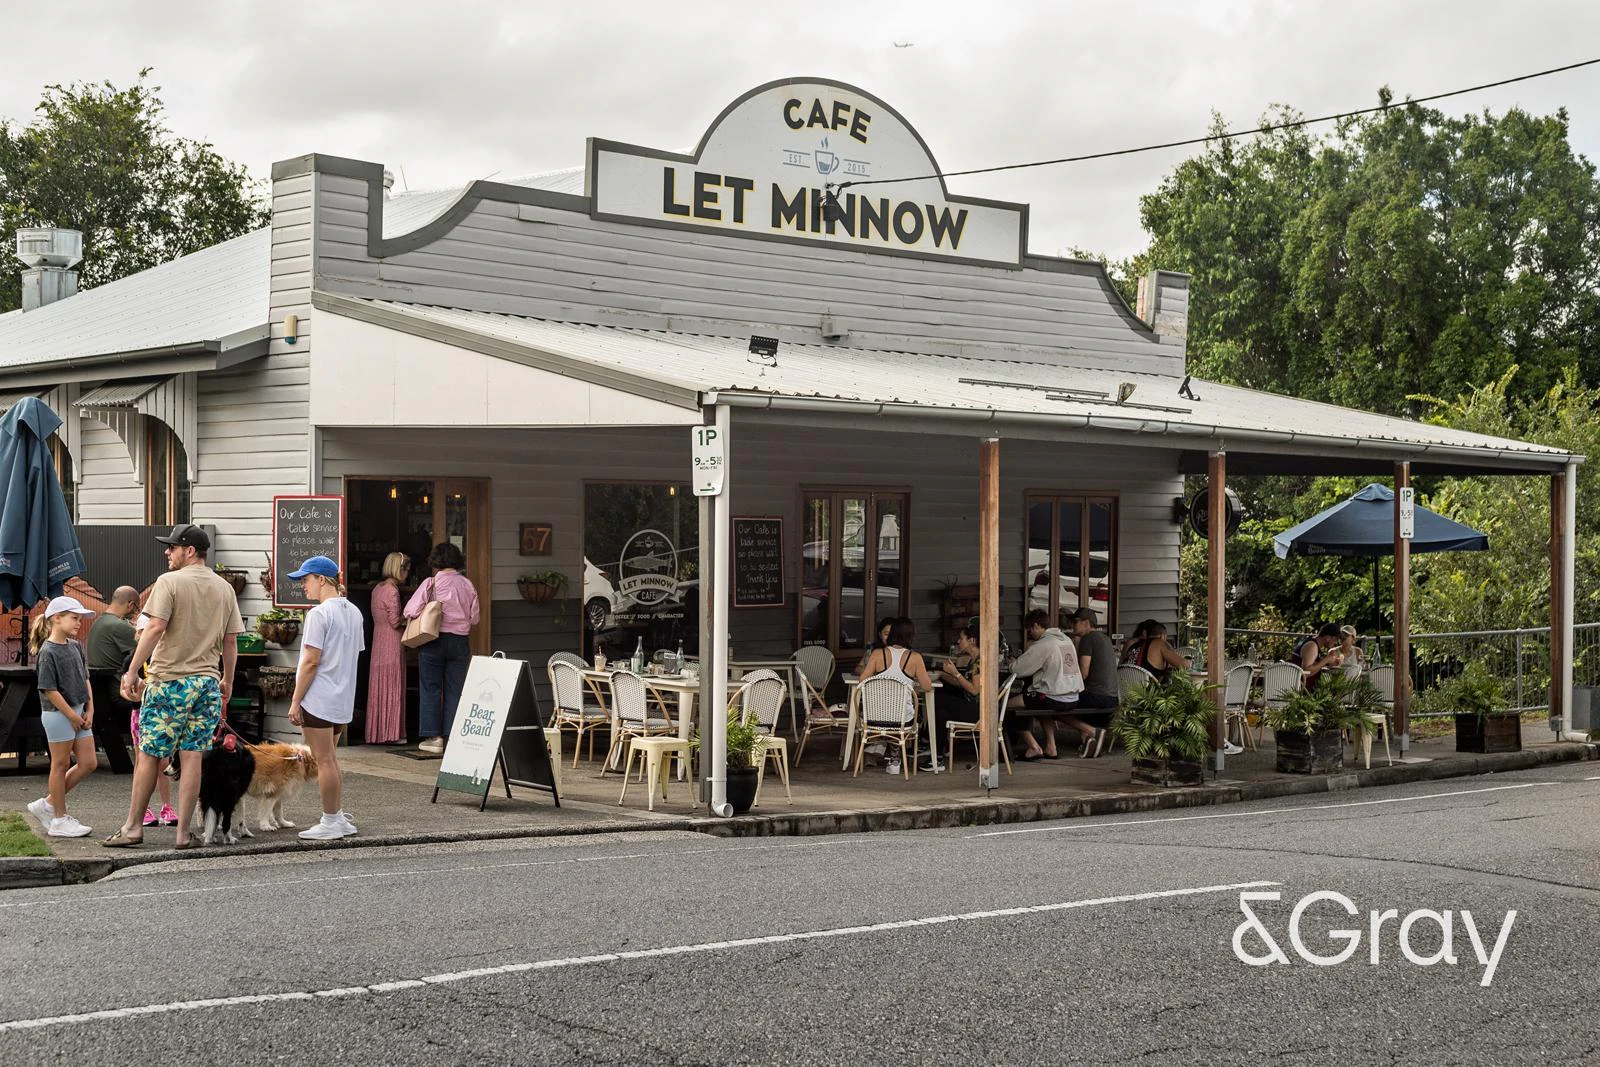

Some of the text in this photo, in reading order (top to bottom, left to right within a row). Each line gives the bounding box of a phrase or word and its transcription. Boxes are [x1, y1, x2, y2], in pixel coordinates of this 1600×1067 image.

[783, 98, 872, 144] CAFE
[663, 166, 969, 250] LET MINNOW
[698, 429, 717, 446] 1P
[280, 506, 332, 519] Our Cafe is
[287, 522, 310, 533] table
[522, 527, 551, 551] 57
[623, 577, 674, 590] LET MINNOW
[641, 591, 656, 600] CAFE
[469, 703, 495, 720] Bear
[461, 718, 495, 737] Beard
